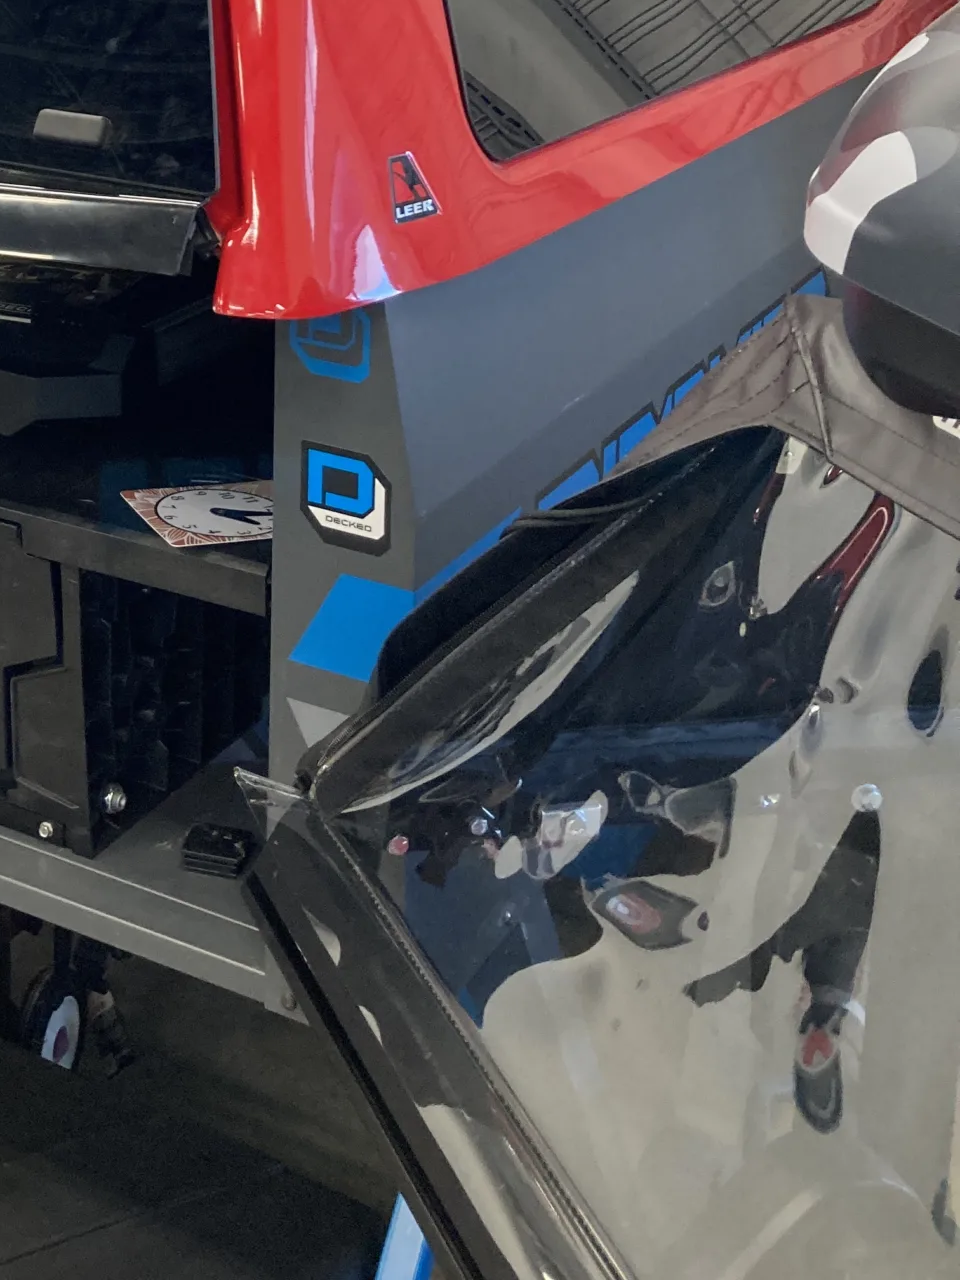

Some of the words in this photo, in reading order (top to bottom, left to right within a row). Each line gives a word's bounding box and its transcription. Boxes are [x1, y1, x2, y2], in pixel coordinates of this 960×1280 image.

[395, 199, 434, 218] LEER
[219, 491, 236, 500] 10
[325, 514, 372, 533] DECKED
